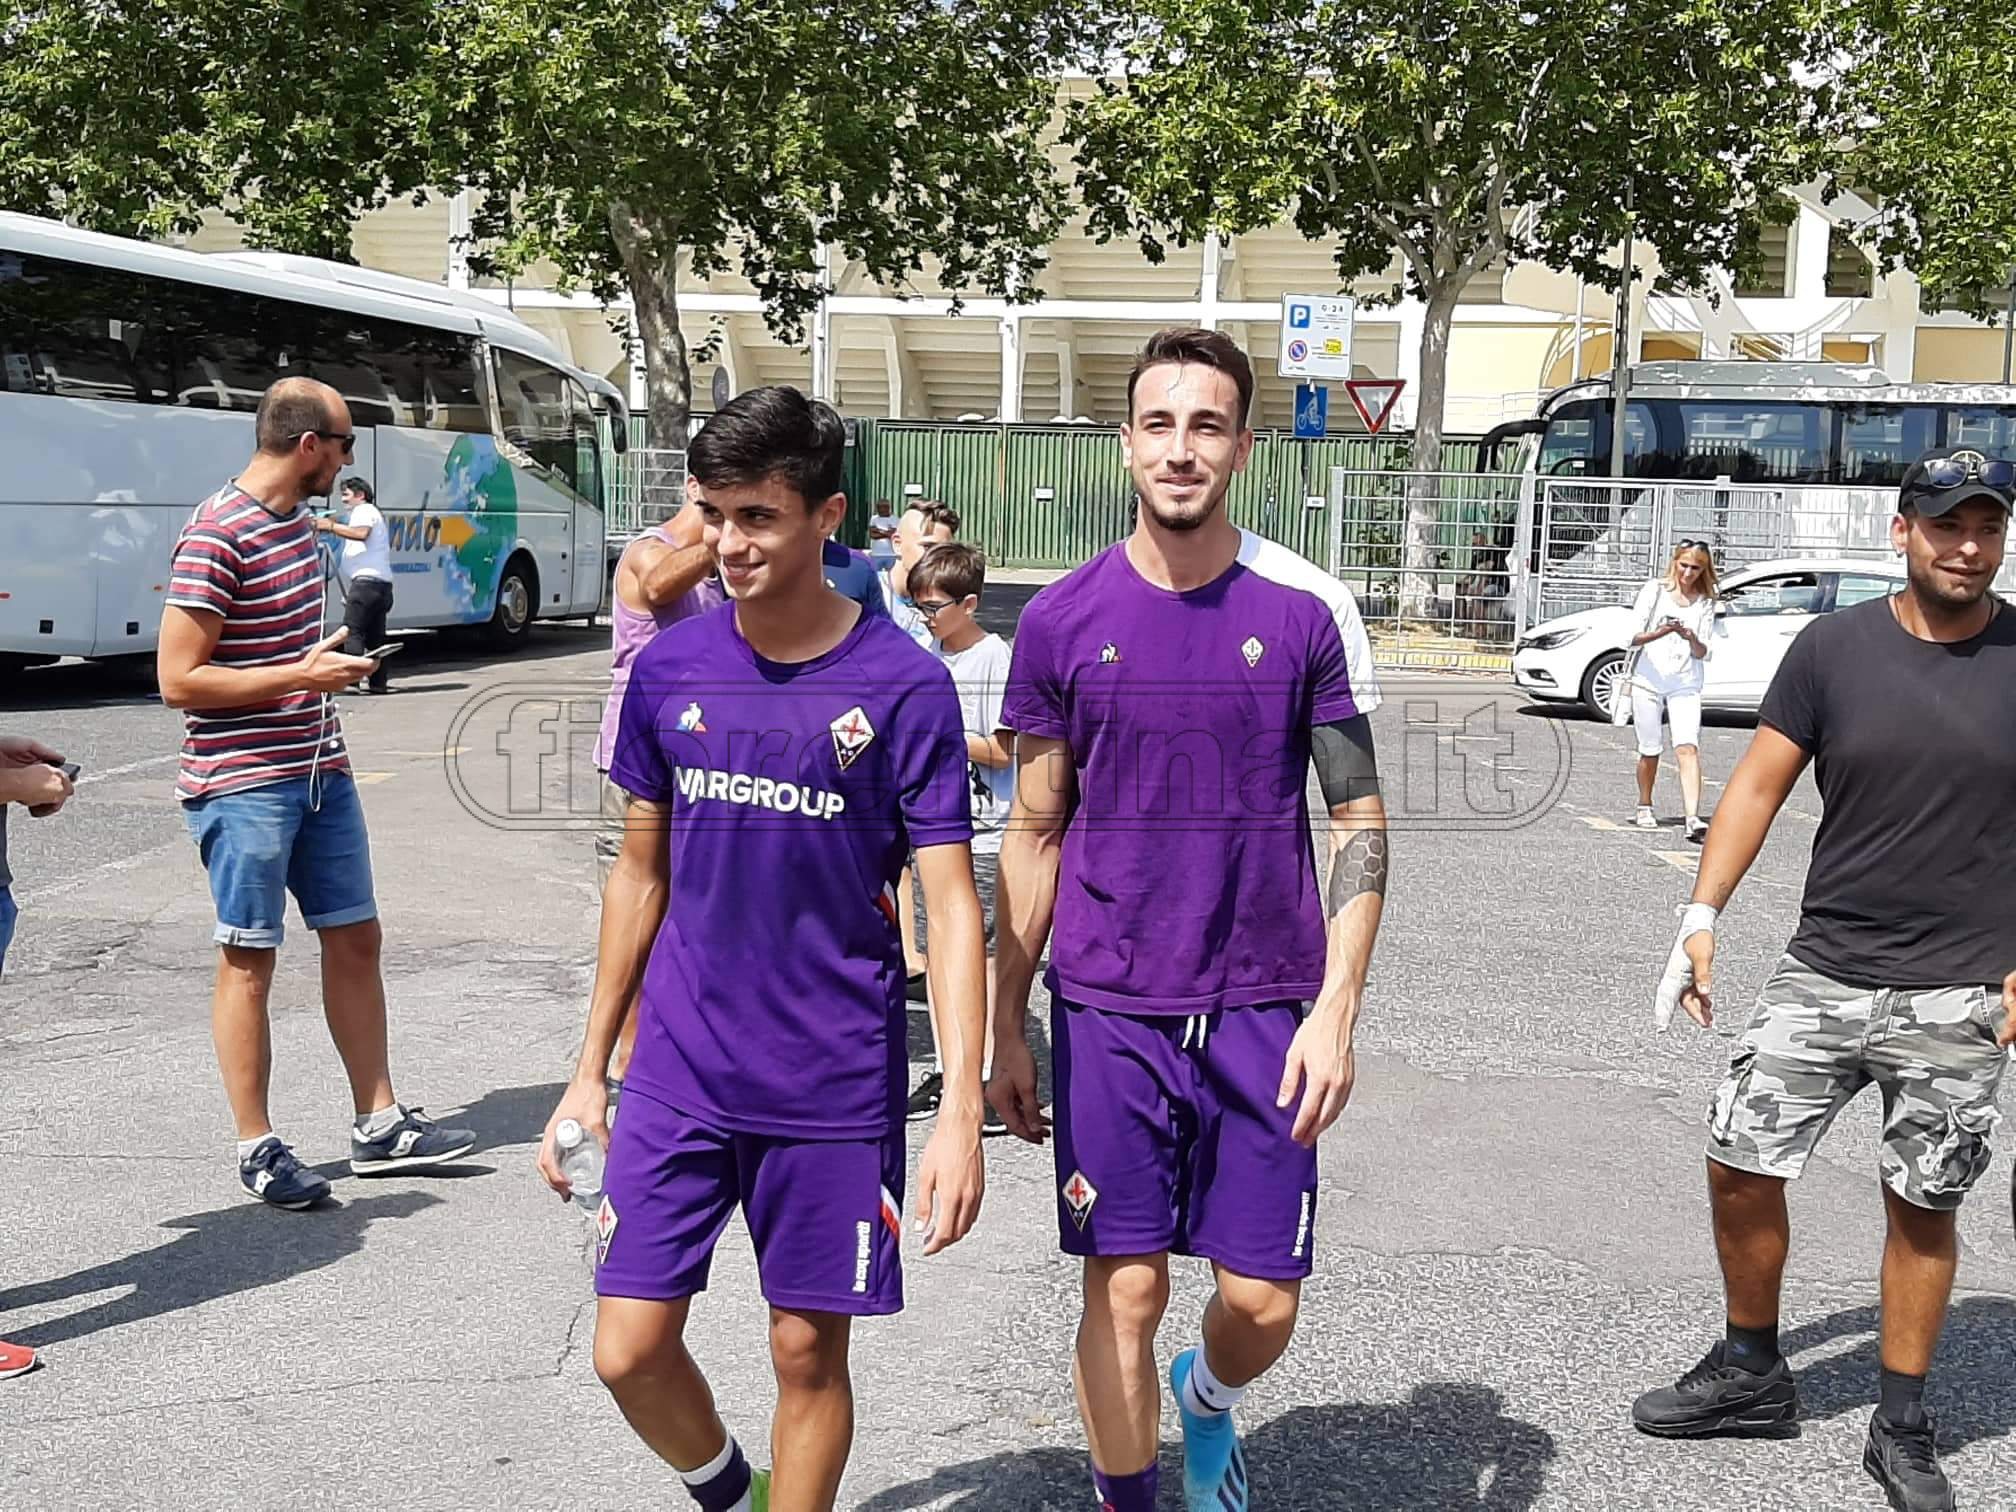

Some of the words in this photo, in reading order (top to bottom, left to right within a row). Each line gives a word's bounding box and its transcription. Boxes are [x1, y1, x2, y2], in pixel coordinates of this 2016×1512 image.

[1293, 307, 1307, 326] P
[383, 490, 442, 553] ndo
[675, 765, 845, 821] VARGROUP
